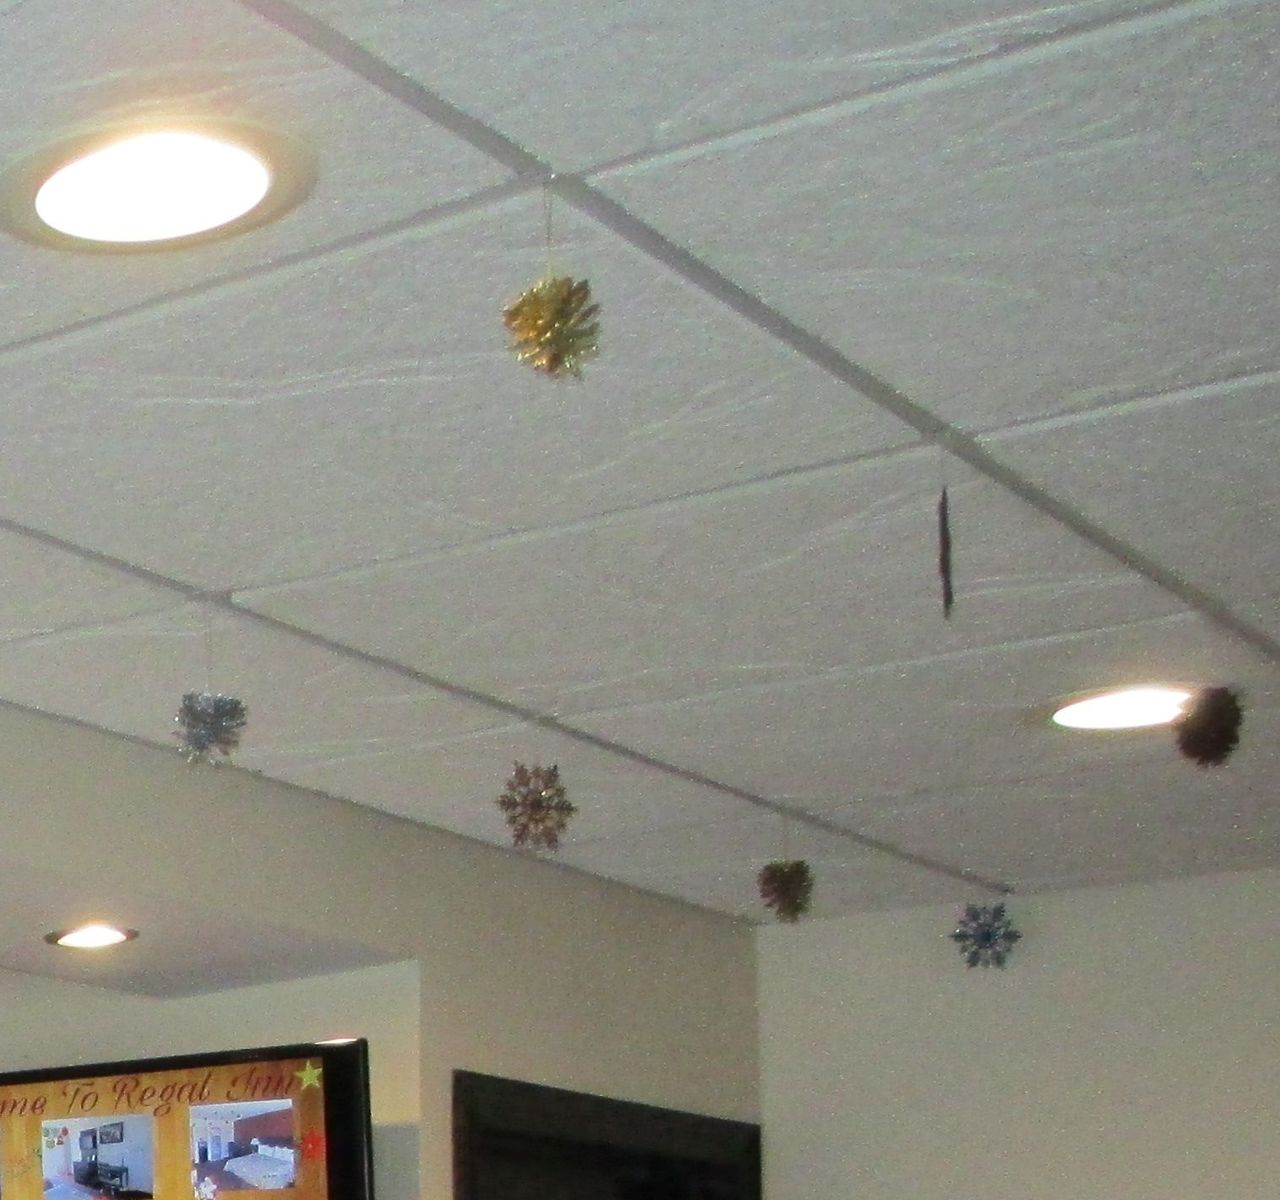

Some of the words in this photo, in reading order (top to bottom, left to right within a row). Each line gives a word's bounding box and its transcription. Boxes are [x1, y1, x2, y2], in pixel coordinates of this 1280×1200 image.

[62, 1080, 99, 1113] To
[112, 1071, 211, 1117] Regal
[227, 1065, 294, 1101] Inn
